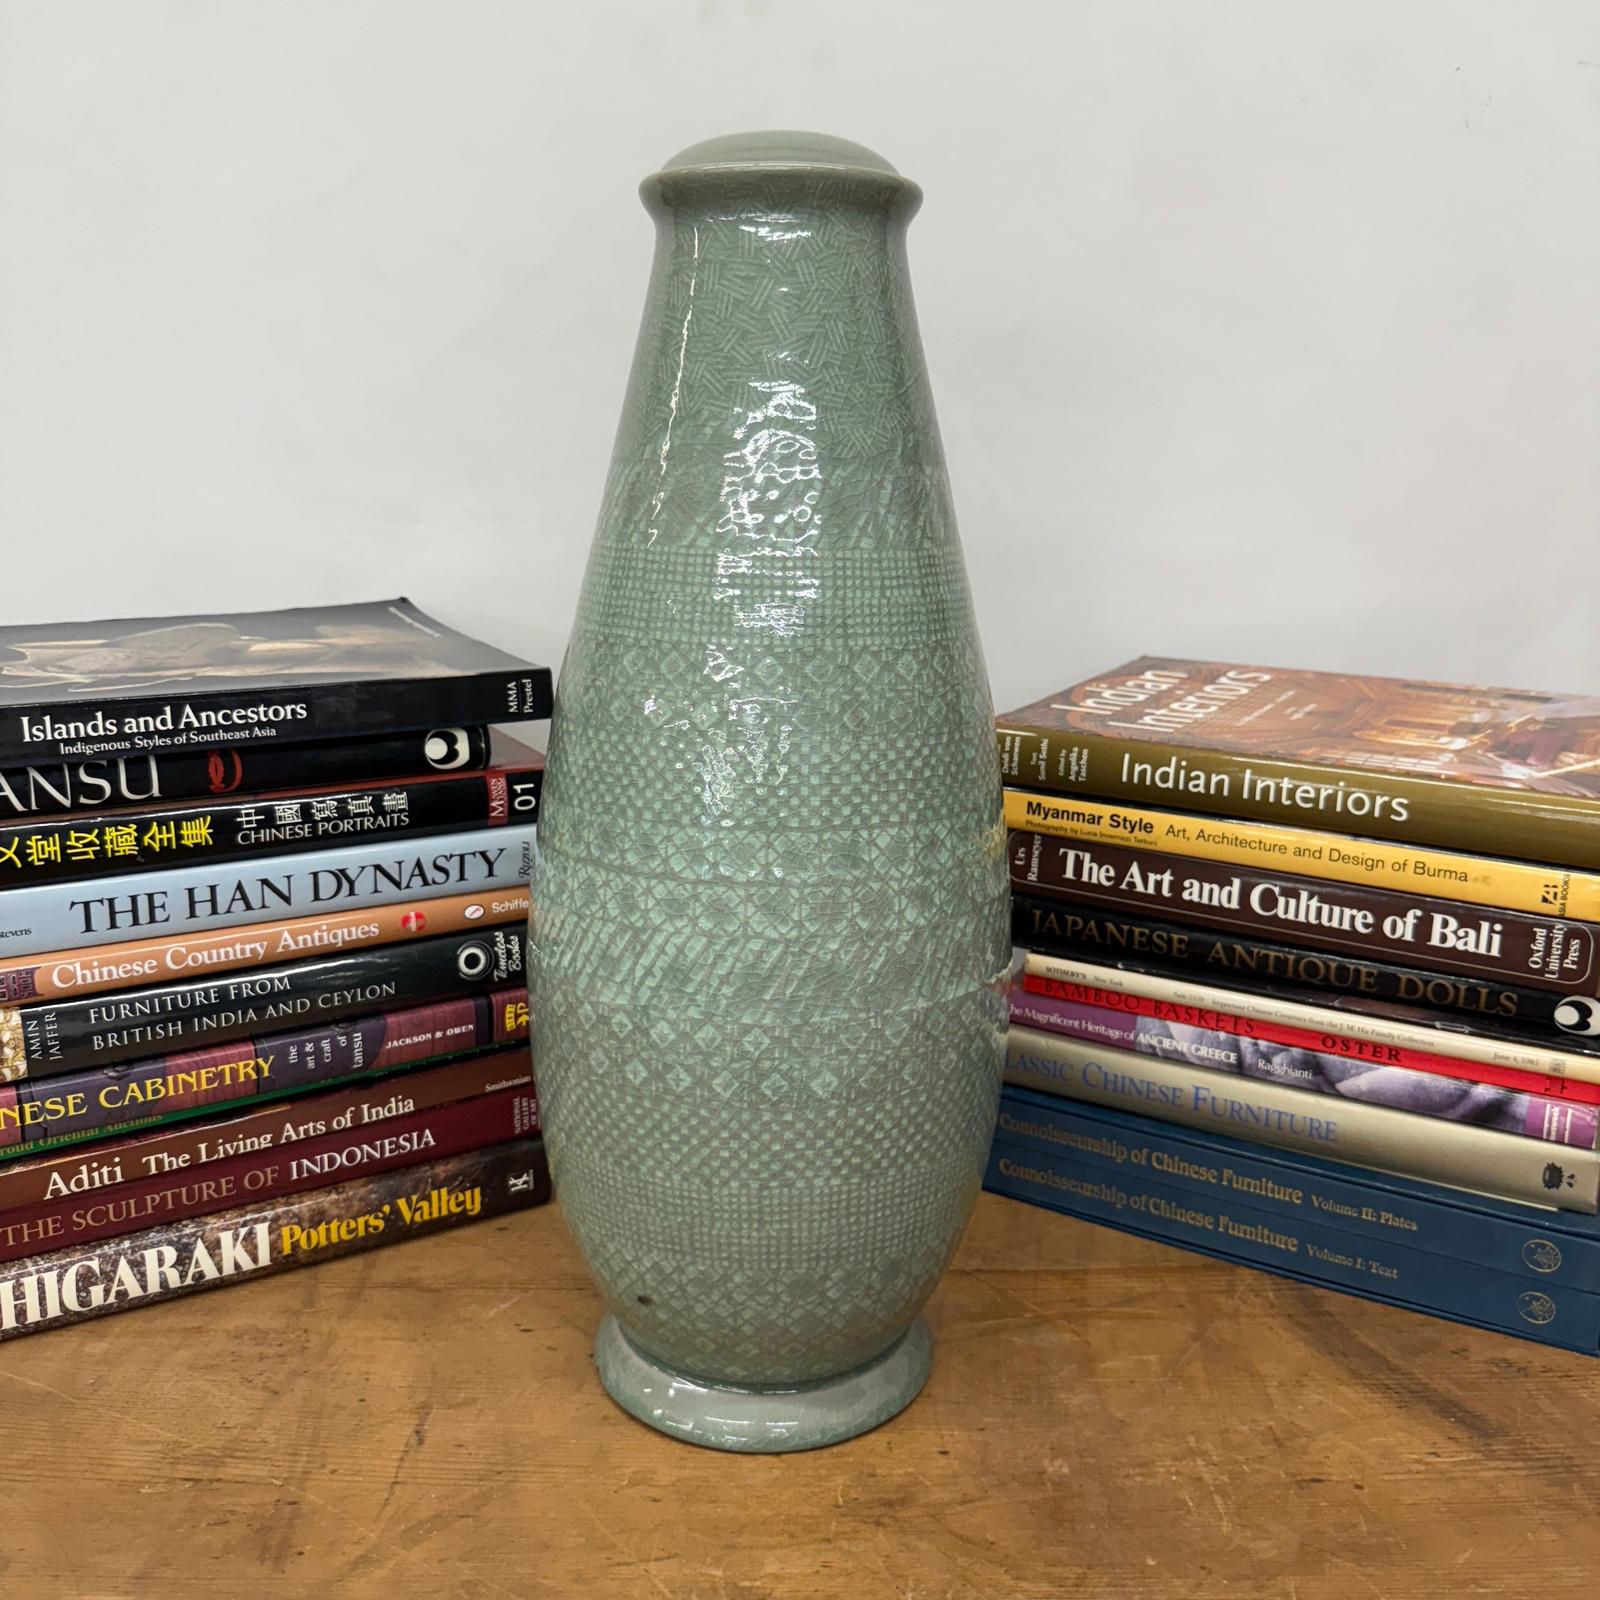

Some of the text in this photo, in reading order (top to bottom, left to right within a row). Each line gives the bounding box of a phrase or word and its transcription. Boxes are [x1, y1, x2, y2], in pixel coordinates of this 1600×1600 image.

[507, 681, 518, 713] MMA
[522, 678, 534, 713] Prestel
[1051, 669, 1188, 715] Indian
[1108, 670, 1271, 733] Interiors
[20, 702, 307, 742] Islands and Ancestors
[60, 726, 277, 755] Indigenous Styles of Southeast Asia
[514, 783, 535, 811] 01
[1121, 753, 1409, 822] Indian Interiors
[237, 812, 409, 845] CHINESE PORTRAITS
[1026, 801, 1468, 883] Myanmar Style Art, Architecture and Design of Burma
[69, 848, 507, 934] THE HAN DYNASTY
[1059, 848, 1502, 957] The Art and Culture of Bali
[1560, 874, 1571, 901] BOOKS
[52, 923, 380, 989] Chinese Country Antiques
[493, 931, 508, 981] Timeless
[507, 935, 522, 971] Books
[1032, 909, 1518, 1016] JAPANESE ANTIQUE DOLLS
[1528, 928, 1547, 969] Oxford
[1545, 923, 1567, 978] University
[1563, 939, 1580, 969] Press
[89, 977, 291, 1025] FURNITURE FROM
[93, 982, 396, 1050] BRITISH INDIA AND CEYLON
[26, 1020, 42, 1060] AMIN
[44, 1012, 64, 1060] JAFFER
[288, 1045, 298, 1063] the
[321, 1038, 332, 1062] craft
[337, 1035, 347, 1047] of
[386, 1023, 474, 1049] JACKSON & OWEN
[1024, 1007, 1080, 1032] Magnificent
[1081, 1018, 1124, 1041] Heritage
[1123, 1029, 1136, 1041] of
[1136, 1032, 1189, 1054] ANCIENT
[1191, 1045, 1238, 1064] GREECE
[1257, 1059, 1313, 1080] Ragghianti
[1154, 1000, 1254, 1034] BASKETS
[1321, 1035, 1401, 1062] OSTER
[305, 1042, 316, 1069] art &
[99, 1055, 275, 1108] CABINETRY
[485, 1075, 532, 1092] Smithsonian
[1082, 1061, 1183, 1107] CHINESE
[1191, 1085, 1338, 1142] FURNITURE
[43, 1095, 415, 1200] Aditi The Living Arts of India
[999, 1112, 1127, 1163] Connoisseurship
[1131, 1147, 1150, 1165] of
[1151, 1151, 1217, 1184] Chinese
[1222, 1170, 1303, 1204] Furniture
[1312, 1195, 1358, 1218] Volume
[1380, 1212, 1418, 1231] Plates
[0, 1128, 437, 1247] THE SCULPTURE OF INDONESIA
[999, 1158, 1127, 1210] Connoisseurship
[1130, 1194, 1149, 1211] of
[1149, 1197, 1214, 1229] Chinese
[1218, 1215, 1298, 1252] Furniture
[1306, 1244, 1353, 1266] Volume
[1369, 1260, 1398, 1279] Text
[0, 1222, 272, 1330] HIGARAKI
[397, 1185, 482, 1226] Valley
